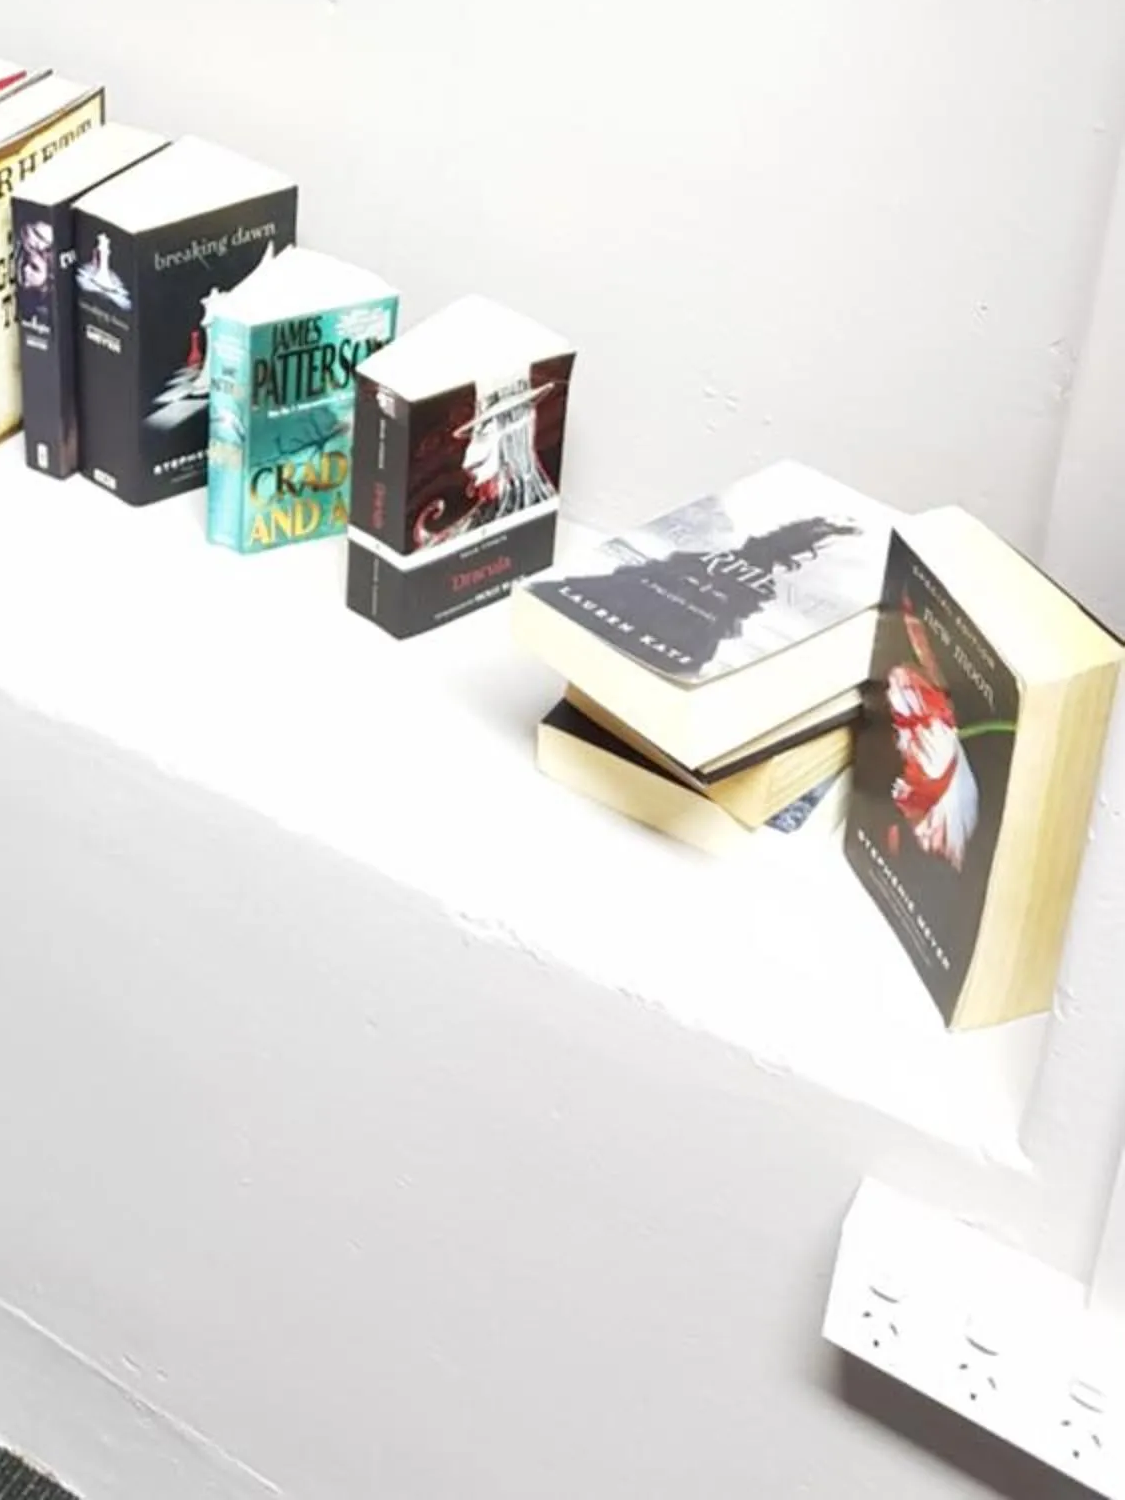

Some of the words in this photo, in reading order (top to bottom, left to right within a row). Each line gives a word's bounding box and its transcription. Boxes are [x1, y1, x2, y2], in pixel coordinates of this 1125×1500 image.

[154, 234, 229, 271] breaking
[230, 221, 276, 247] dawn
[270, 315, 323, 356] JAMES
[250, 450, 349, 508] CRAD
[249, 498, 321, 549] AND
[559, 585, 635, 634] LAUREN
[639, 633, 694, 666] KATE
[923, 606, 951, 647] new
[857, 828, 915, 915] STEPHENIE
[916, 914, 952, 972] MEYER
